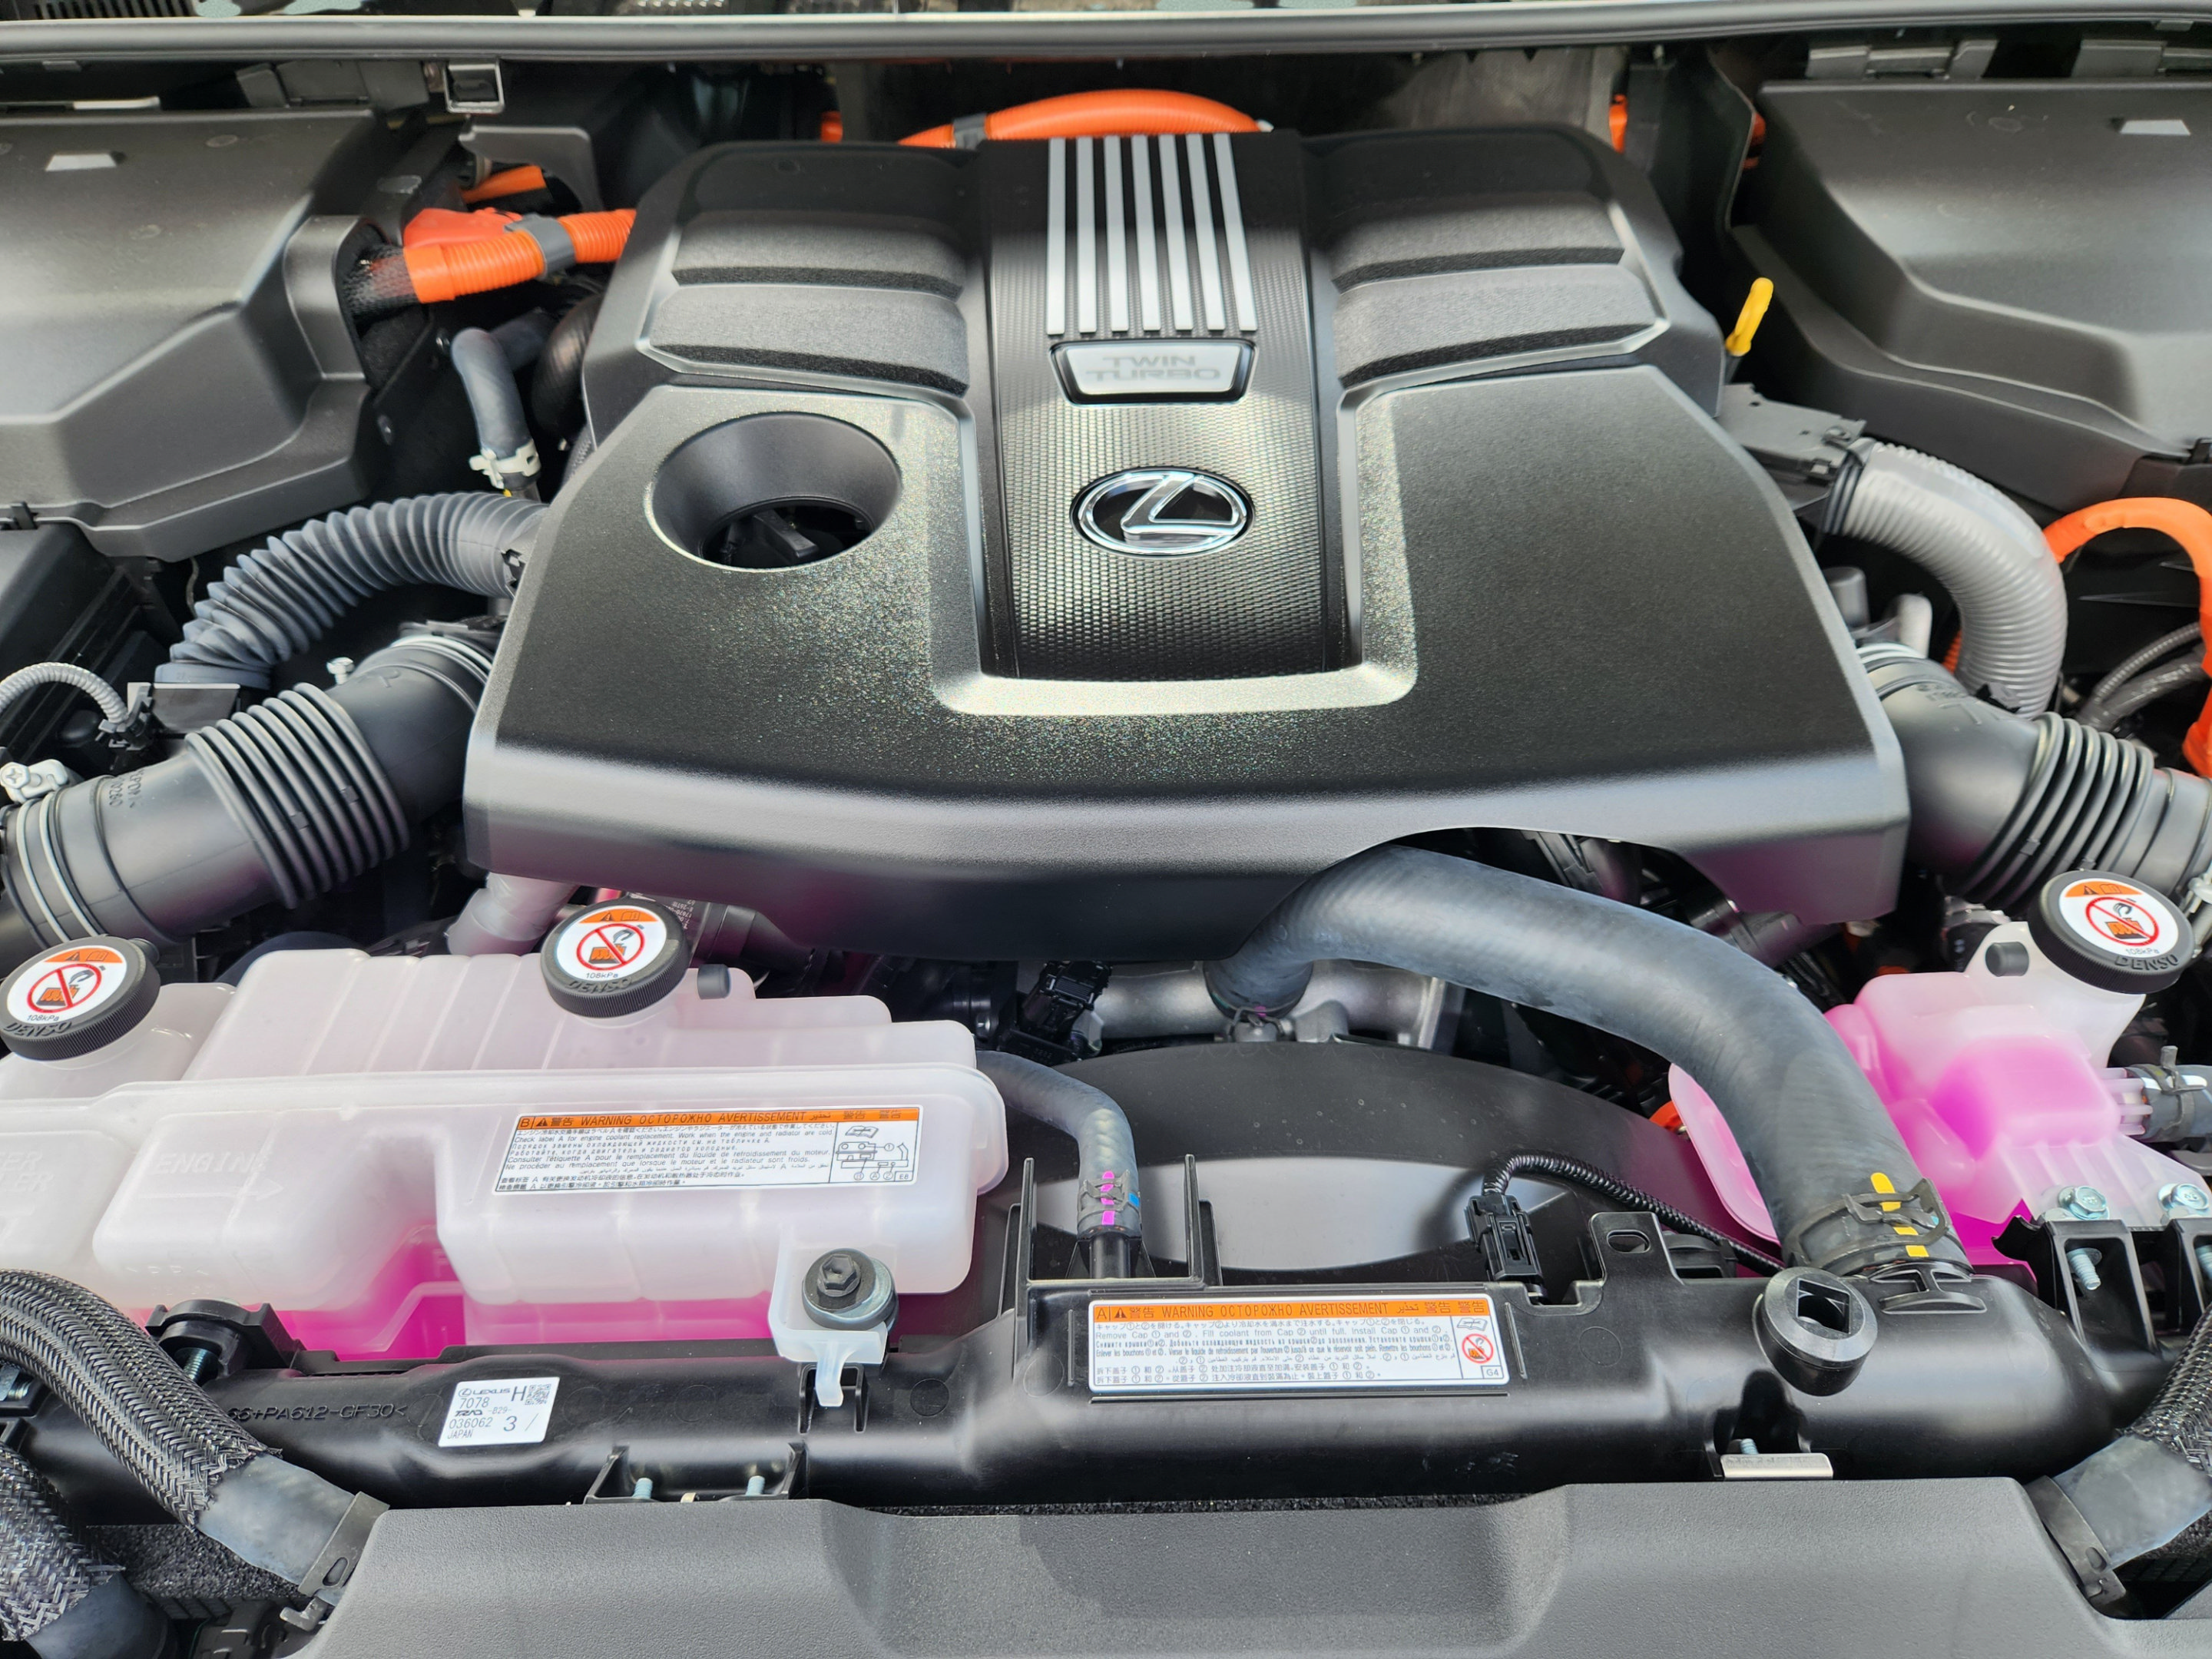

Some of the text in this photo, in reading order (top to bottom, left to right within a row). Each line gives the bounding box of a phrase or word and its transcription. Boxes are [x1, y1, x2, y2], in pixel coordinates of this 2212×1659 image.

[1103, 356, 1196, 367] TWIN
[1086, 369, 1221, 382] TURBO
[2114, 954, 2180, 971] DENSO
[566, 979, 631, 993] DENSO
[3, 1022, 72, 1037] DENSO
[581, 1114, 632, 1127] WARNING
[639, 1112, 712, 1124] ОСТОРОЖНО
[717, 1111, 806, 1123] AVERTISSEMENT
[1097, 1308, 1107, 1320] A
[1162, 1306, 1214, 1318] WARNING
[1220, 1304, 1293, 1317] ОСТОРОЖНО
[1300, 1303, 1388, 1316] AVERTISSEMENT
[1486, 1368, 1498, 1376] G4
[511, 1386, 527, 1402] H
[459, 1397, 490, 1409] 7078
[449, 1416, 517, 1432] 036062 3
[447, 1429, 474, 1439] JAPAN
